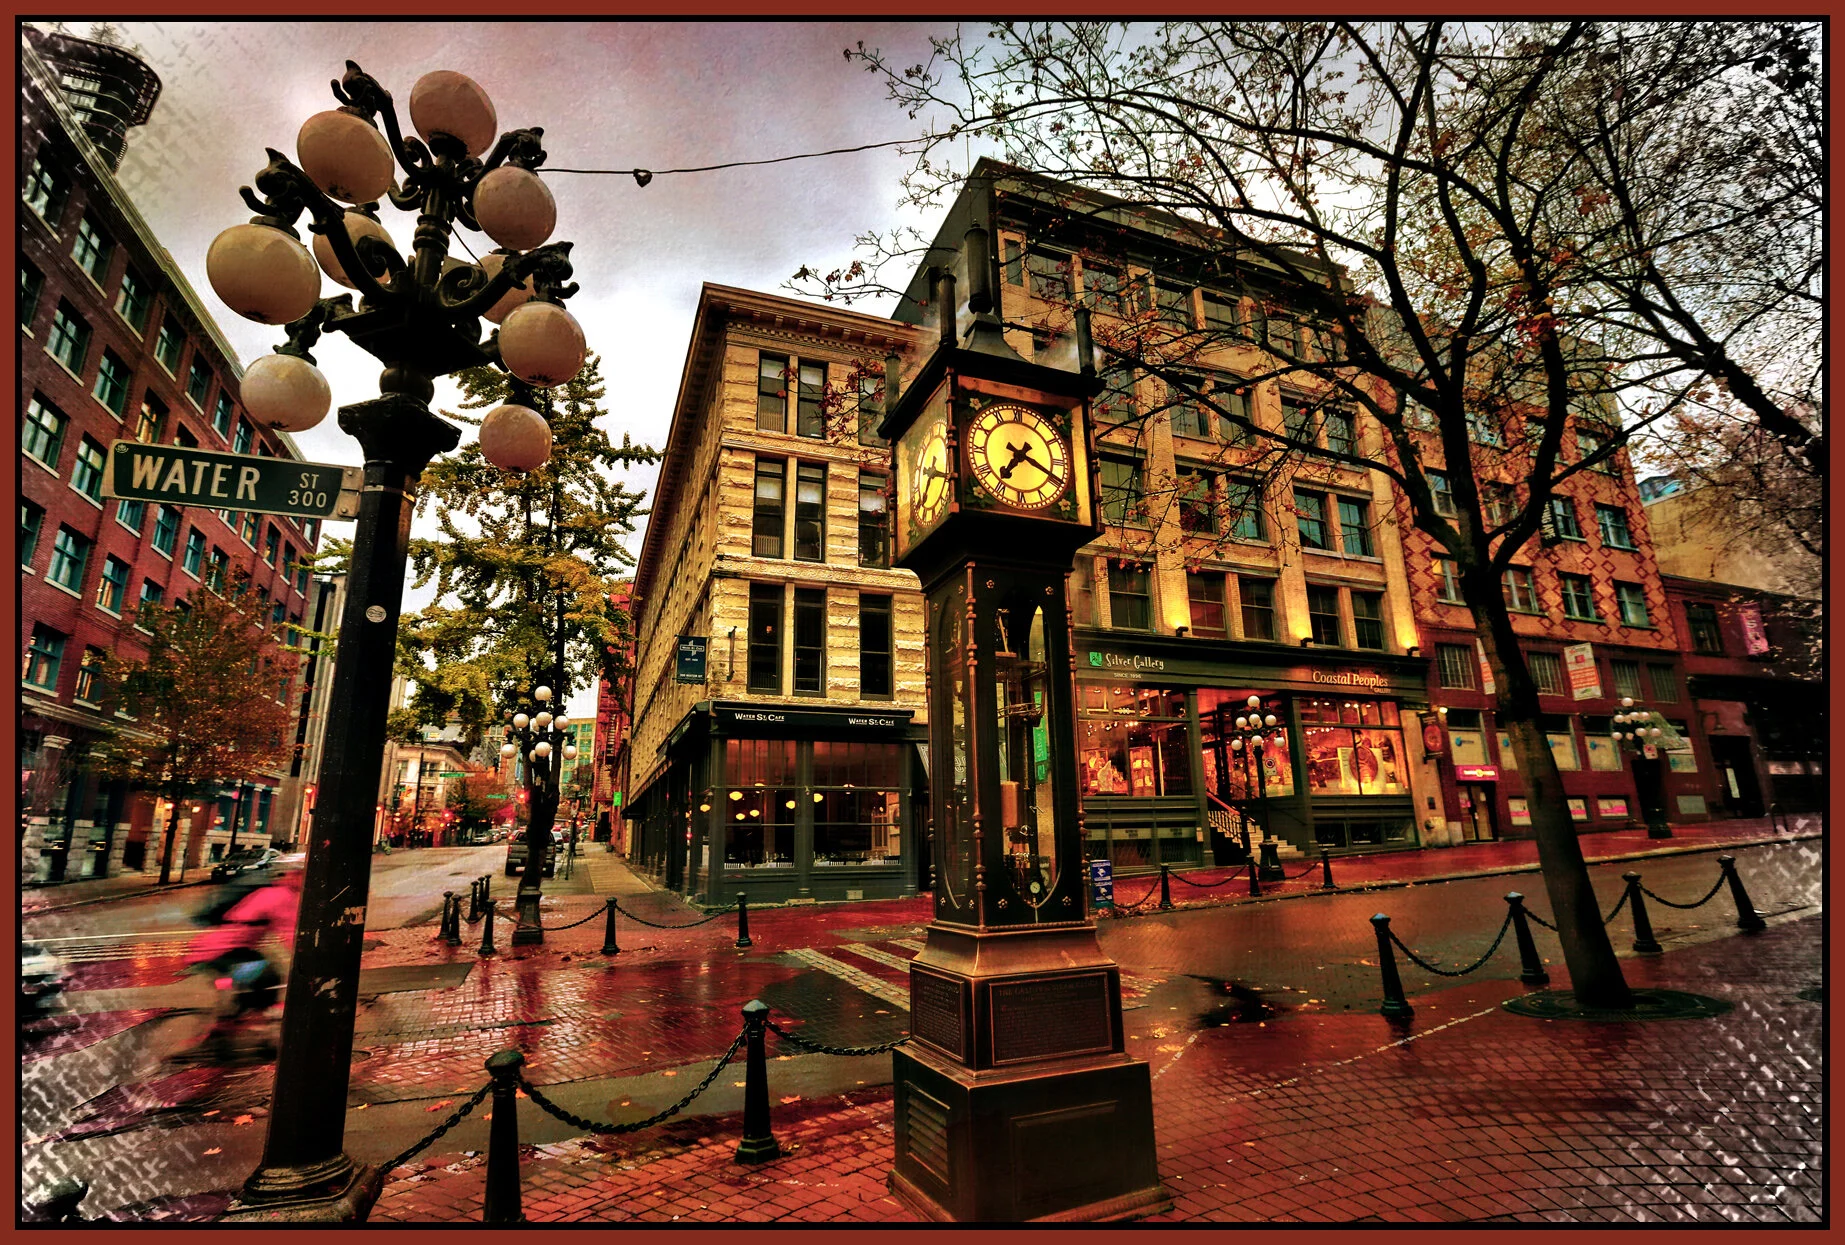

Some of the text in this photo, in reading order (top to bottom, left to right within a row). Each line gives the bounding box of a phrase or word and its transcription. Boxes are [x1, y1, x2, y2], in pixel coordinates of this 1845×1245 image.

[132, 453, 320, 501] WATER ST
[288, 489, 327, 509] 300
[1105, 652, 1164, 670] Silver Gallery
[1312, 671, 1388, 689] Coastal Peoples
